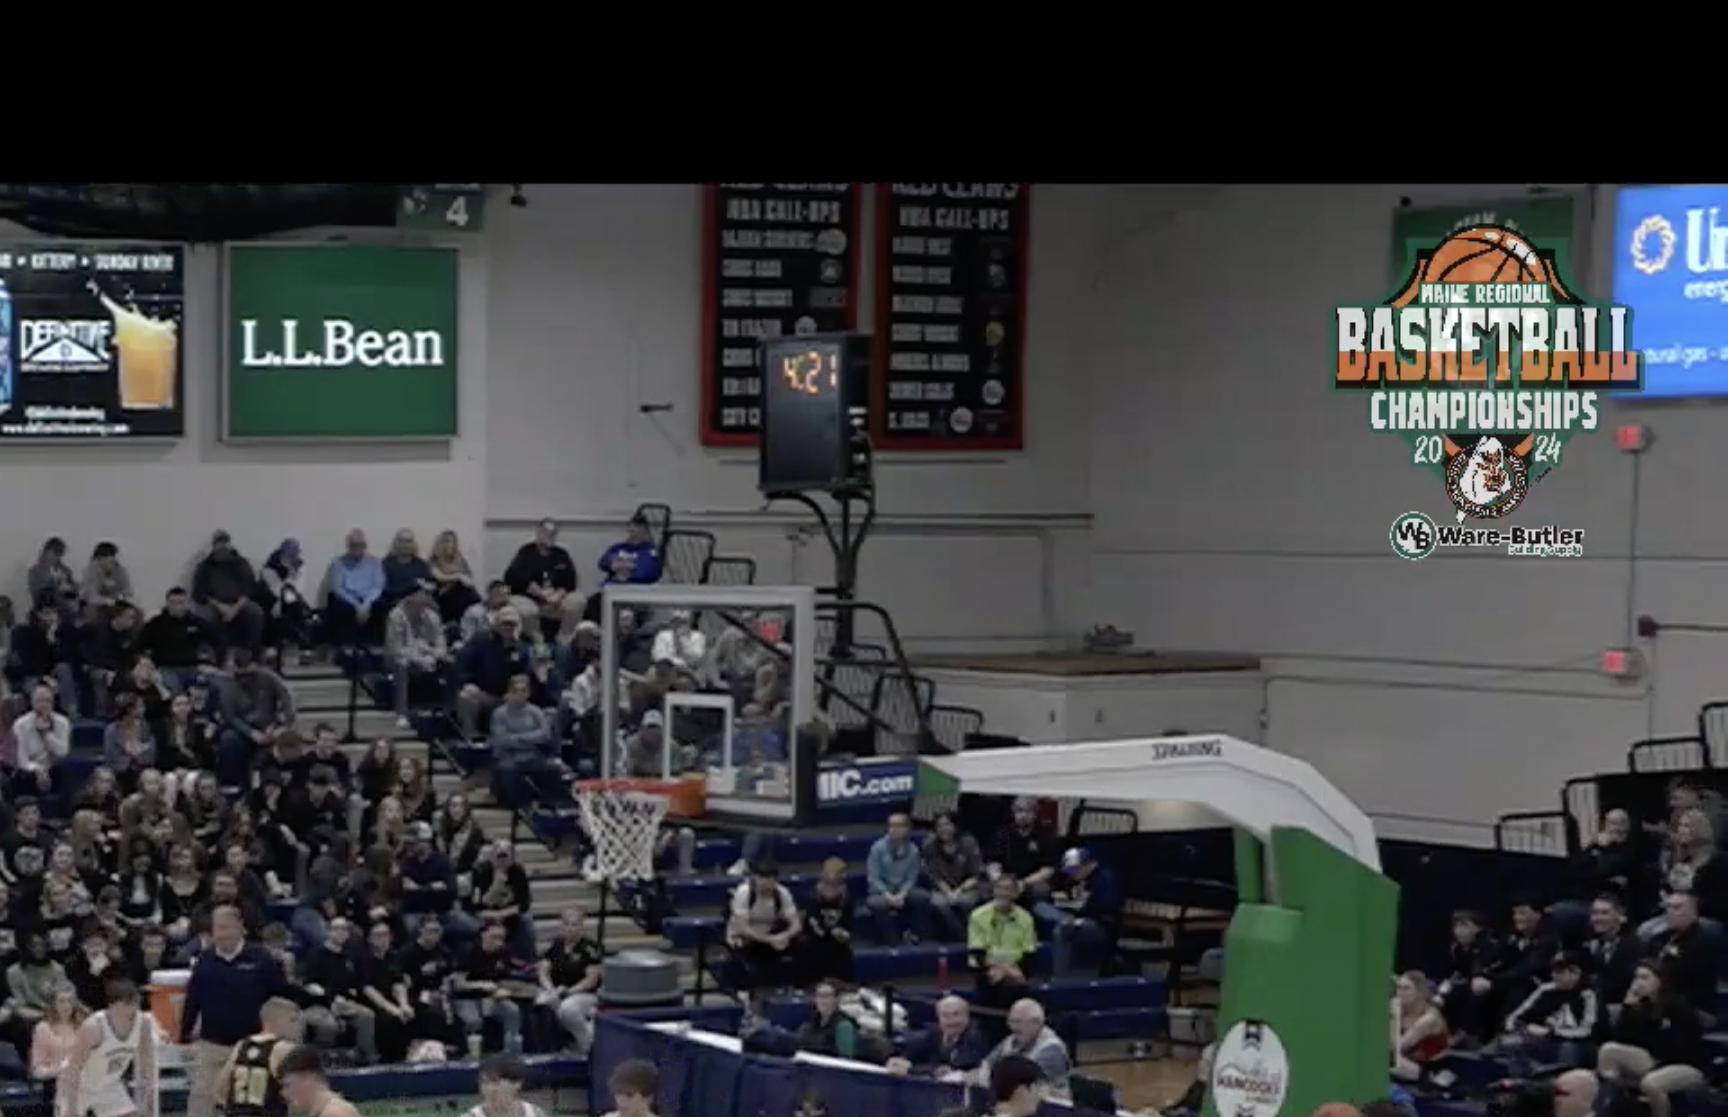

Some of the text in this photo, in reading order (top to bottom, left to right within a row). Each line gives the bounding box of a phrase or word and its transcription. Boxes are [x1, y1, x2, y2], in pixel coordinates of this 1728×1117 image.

[446, 196, 469, 226] 4
[240, 319, 444, 367] L.L.Bean
[1151, 738, 1222, 761] SPALDING
